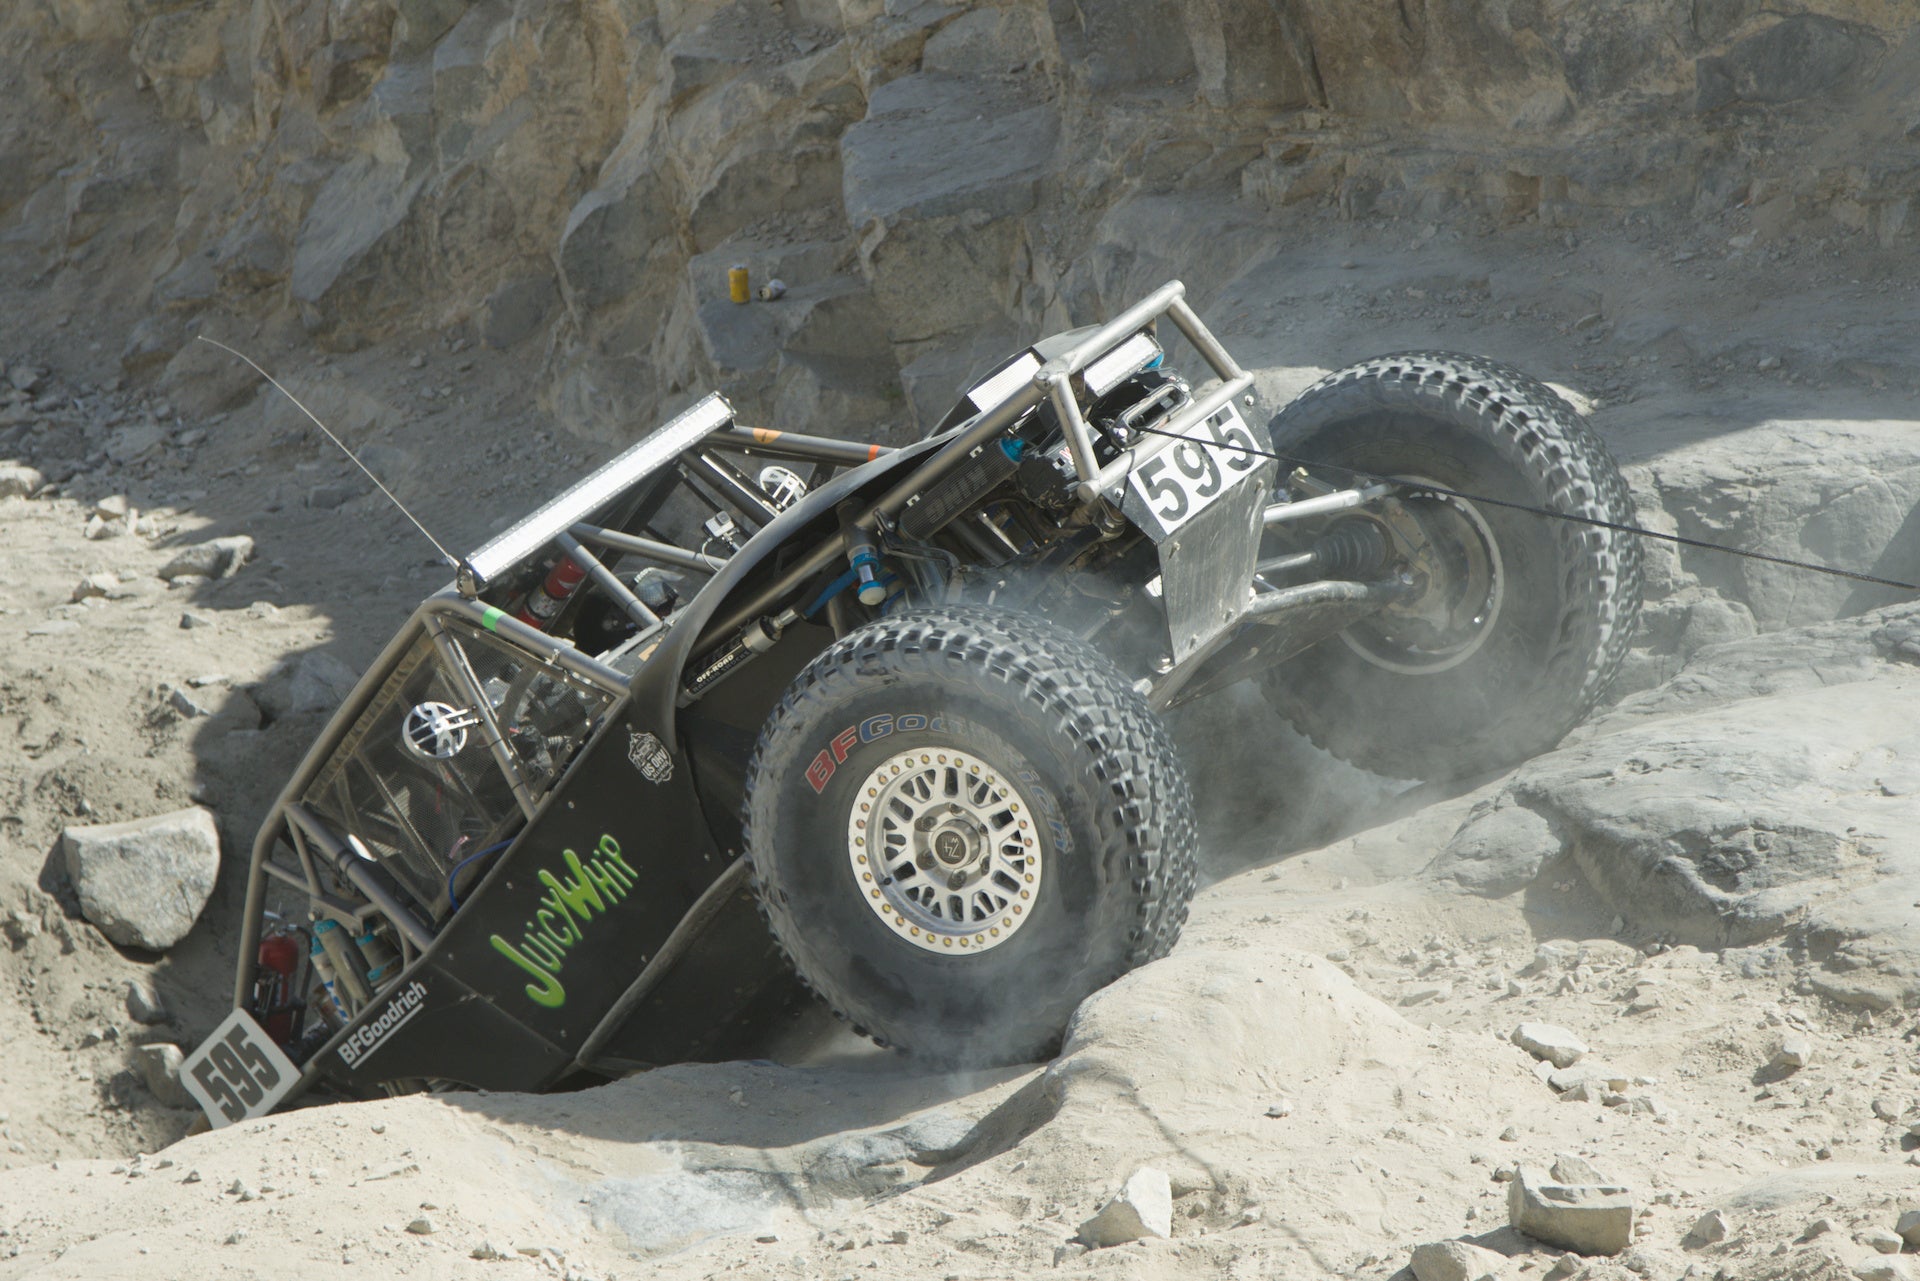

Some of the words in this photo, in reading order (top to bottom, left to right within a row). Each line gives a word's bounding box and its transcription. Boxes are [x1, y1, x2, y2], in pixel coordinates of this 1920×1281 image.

[1136, 405, 1257, 522] 595
[696, 654, 735, 683] OFF-ROAD
[642, 762, 656, 777] US
[650, 748, 668, 768] OHV
[804, 713, 1075, 853] BFGoich
[337, 981, 428, 1065] BFGoodrich
[190, 1022, 281, 1124] 595
